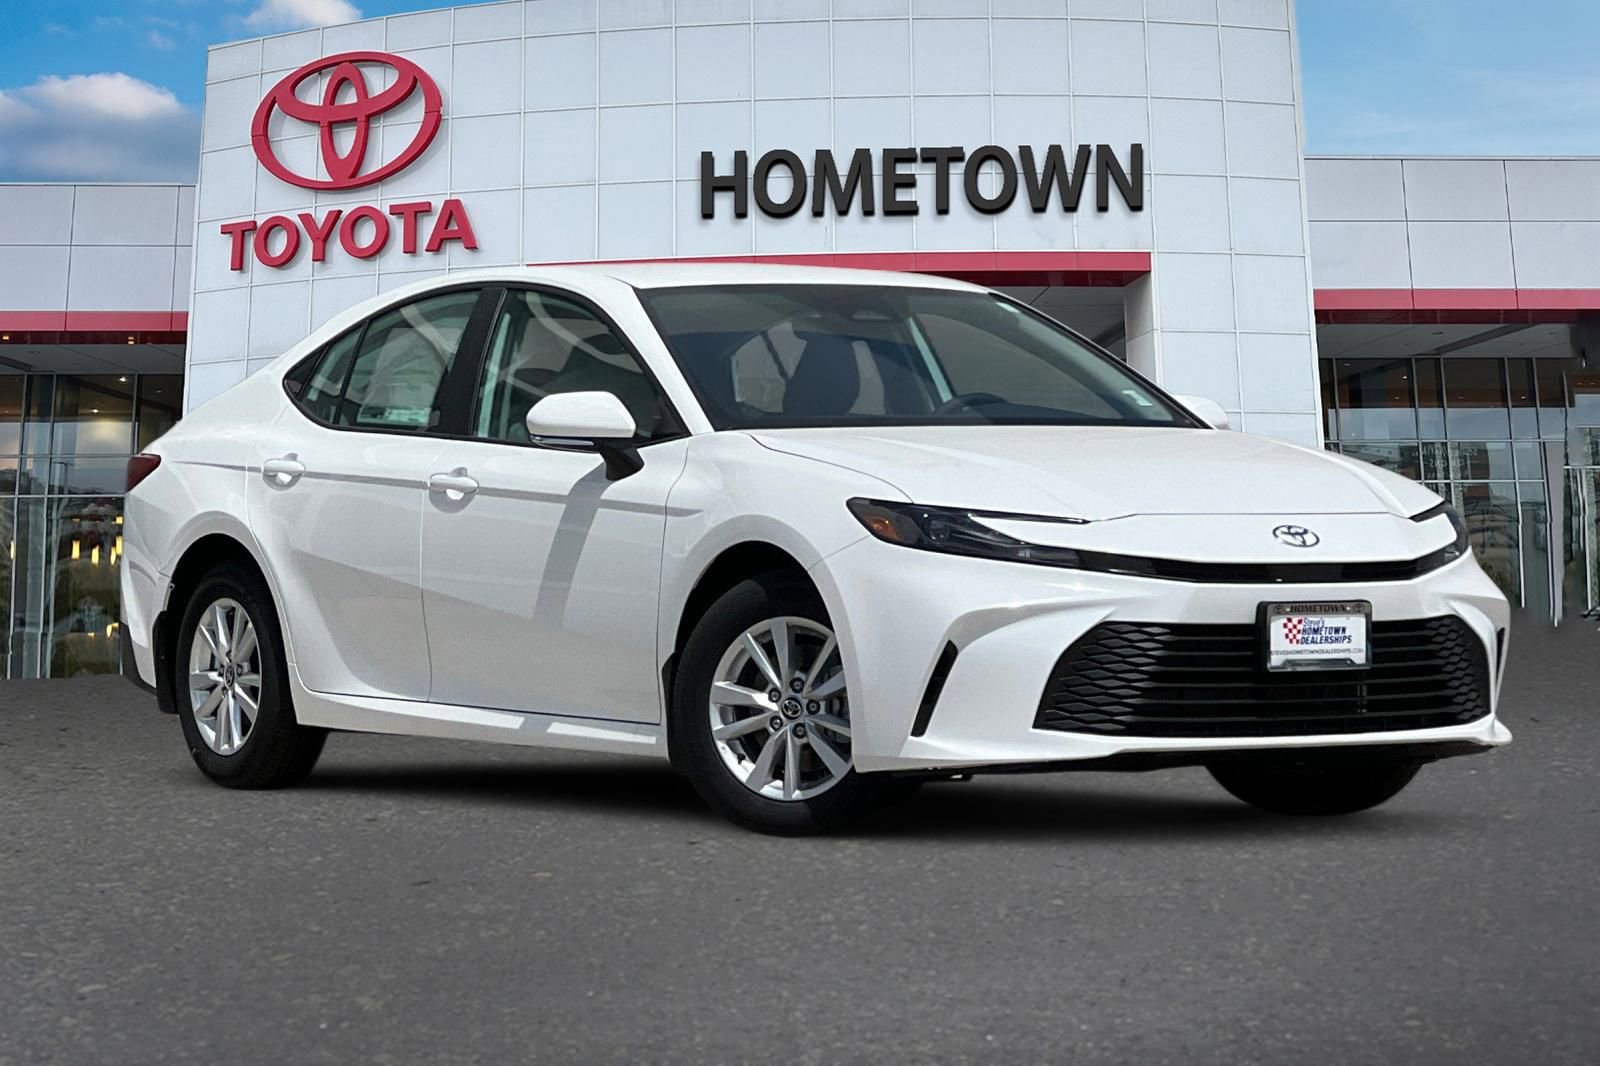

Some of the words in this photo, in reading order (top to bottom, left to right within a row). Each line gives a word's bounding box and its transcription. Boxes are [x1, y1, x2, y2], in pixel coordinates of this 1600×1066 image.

[700, 143, 1144, 219] HOMETOWN
[220, 198, 479, 272] TOYOTA
[1290, 604, 1347, 613] HOMETOWN
[1303, 617, 1325, 627] Steve's
[1302, 626, 1347, 635] HOMETOWN
[1300, 635, 1352, 645] DEALERSHIPS
